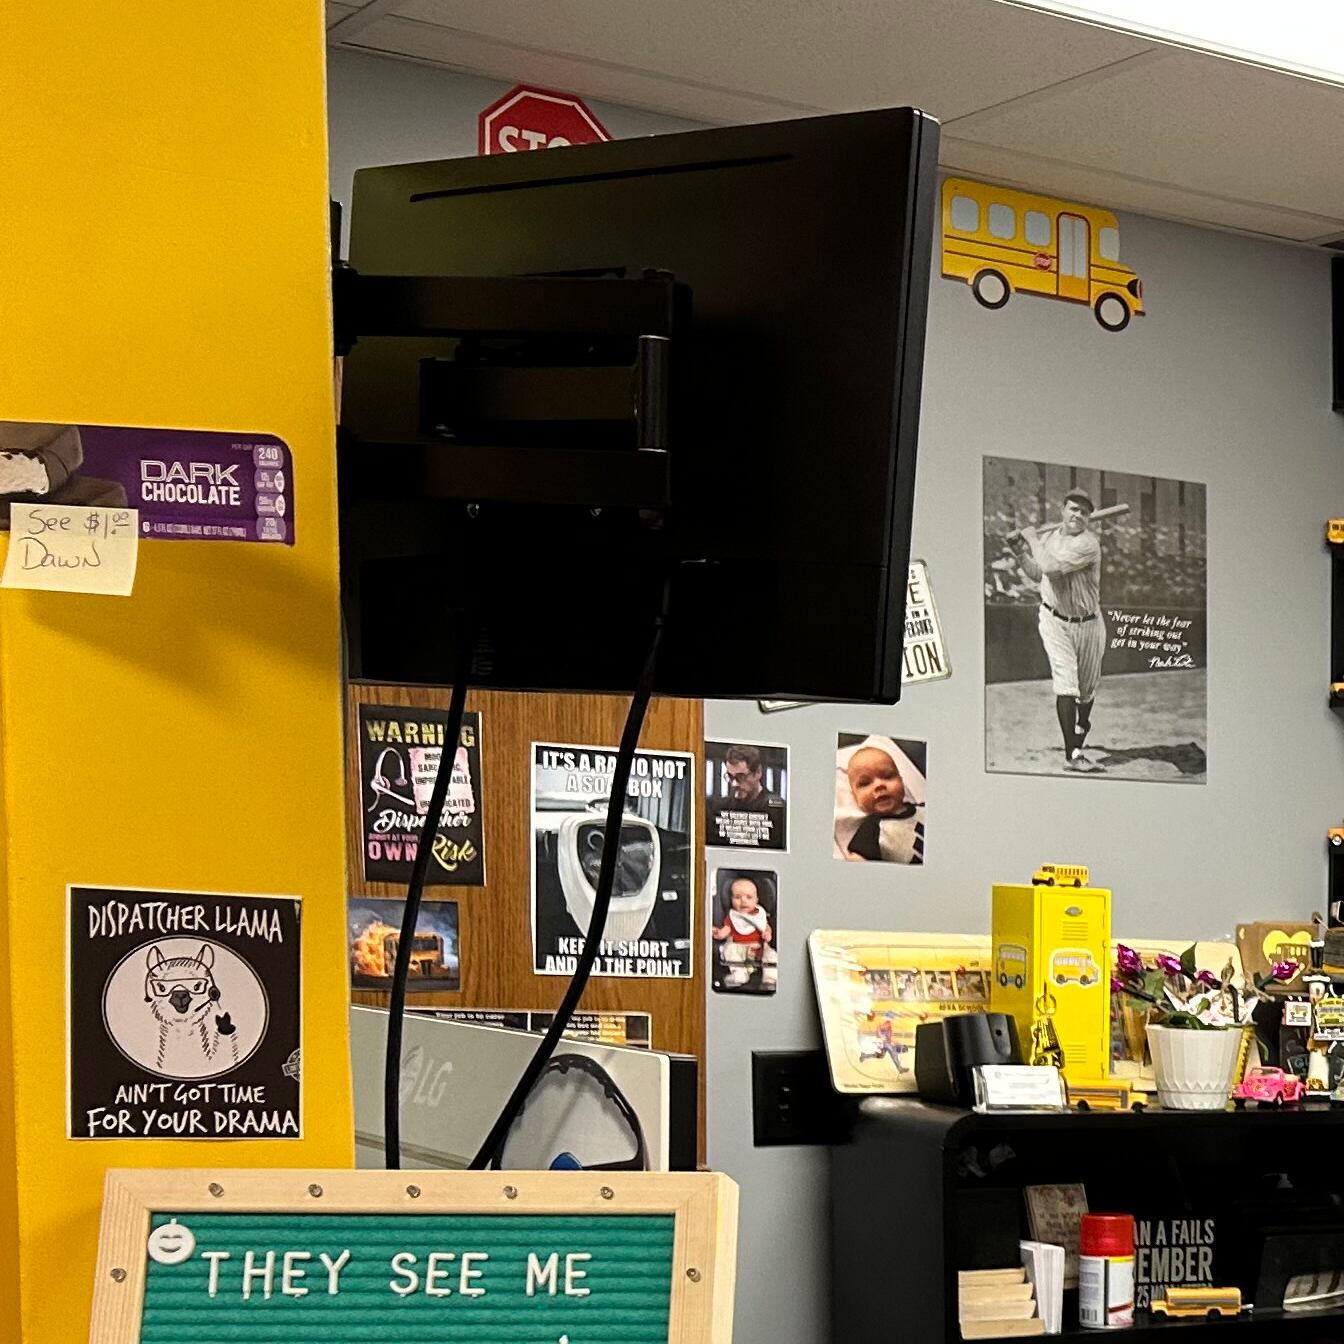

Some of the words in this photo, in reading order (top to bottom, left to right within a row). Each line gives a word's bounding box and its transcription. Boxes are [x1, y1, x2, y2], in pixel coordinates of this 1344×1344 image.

[141, 460, 240, 486] DARK
[142, 483, 240, 505] CHOCOLATE
[27, 509, 72, 535] See
[542, 751, 575, 771] IT'S
[579, 753, 591, 773] A
[594, 755, 648, 777] RAIO
[652, 759, 686, 780] NOT
[88, 900, 209, 938] DISPATCHER
[215, 906, 283, 943] LLAMA
[600, 939, 614, 956] IT
[618, 939, 669, 958] SHORT
[545, 955, 577, 973] AND
[605, 958, 633, 975] THE
[636, 960, 682, 977] POINT
[114, 1084, 171, 1104] AIN'T
[174, 1084, 216, 1104] GOT
[216, 1084, 266, 1103] TIME
[86, 1108, 136, 1137] FOR
[142, 1109, 208, 1134] YOUR
[214, 1110, 299, 1134] DRAMA
[201, 1249, 350, 1299] THEY
[389, 1253, 488, 1297] SEE
[525, 1253, 591, 1297] ME
